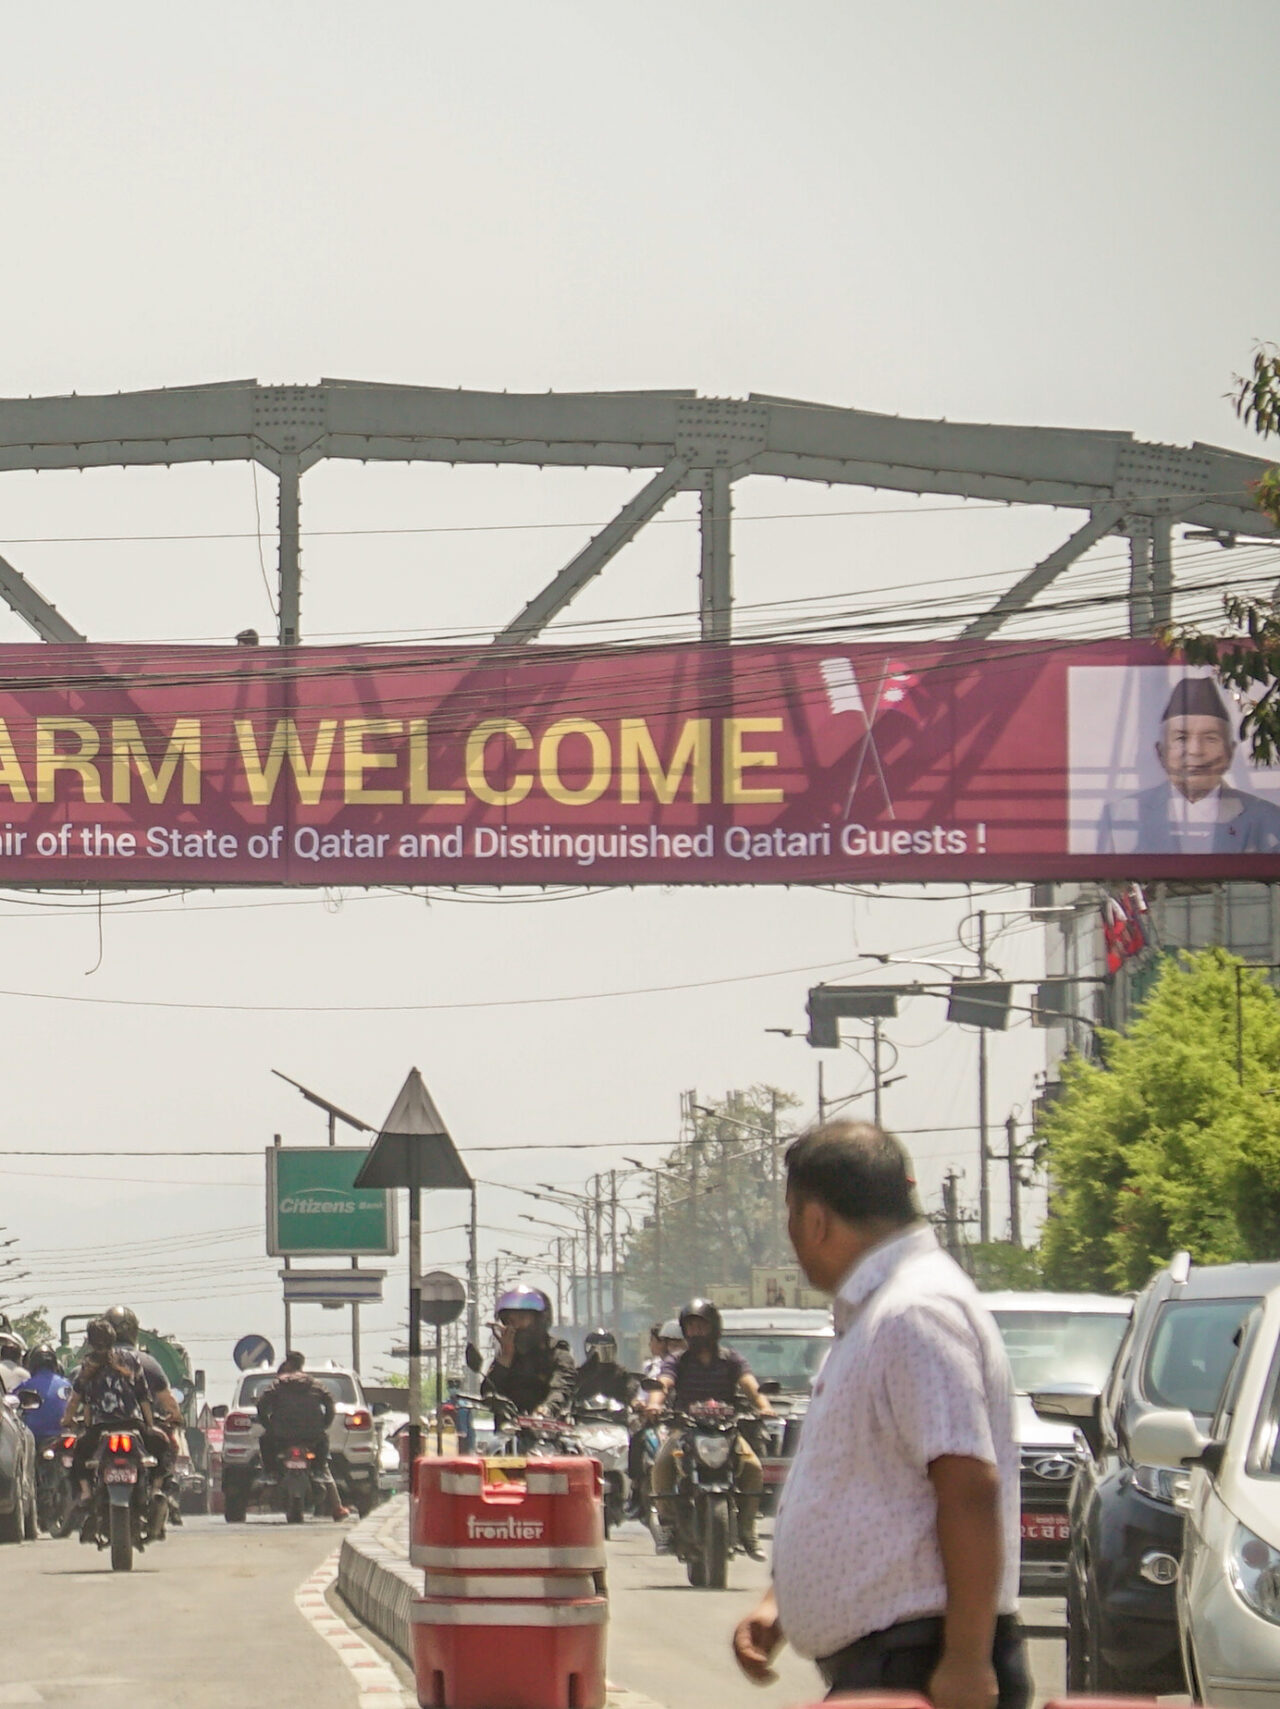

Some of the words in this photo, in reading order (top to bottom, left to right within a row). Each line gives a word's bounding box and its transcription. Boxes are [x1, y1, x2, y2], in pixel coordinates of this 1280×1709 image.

[234, 717, 785, 806] WELCOME
[36, 824, 73, 857] of
[79, 824, 137, 858] the
[146, 826, 238, 858] State
[248, 826, 284, 858] of
[294, 826, 390, 862] Qatar
[399, 825, 463, 858] and
[474, 826, 714, 866] Distinguished
[724, 824, 830, 861] Qatari
[841, 823, 967, 856] Guests
[279, 1198, 355, 1214] Citizens
[467, 1515, 544, 1540] frontier
